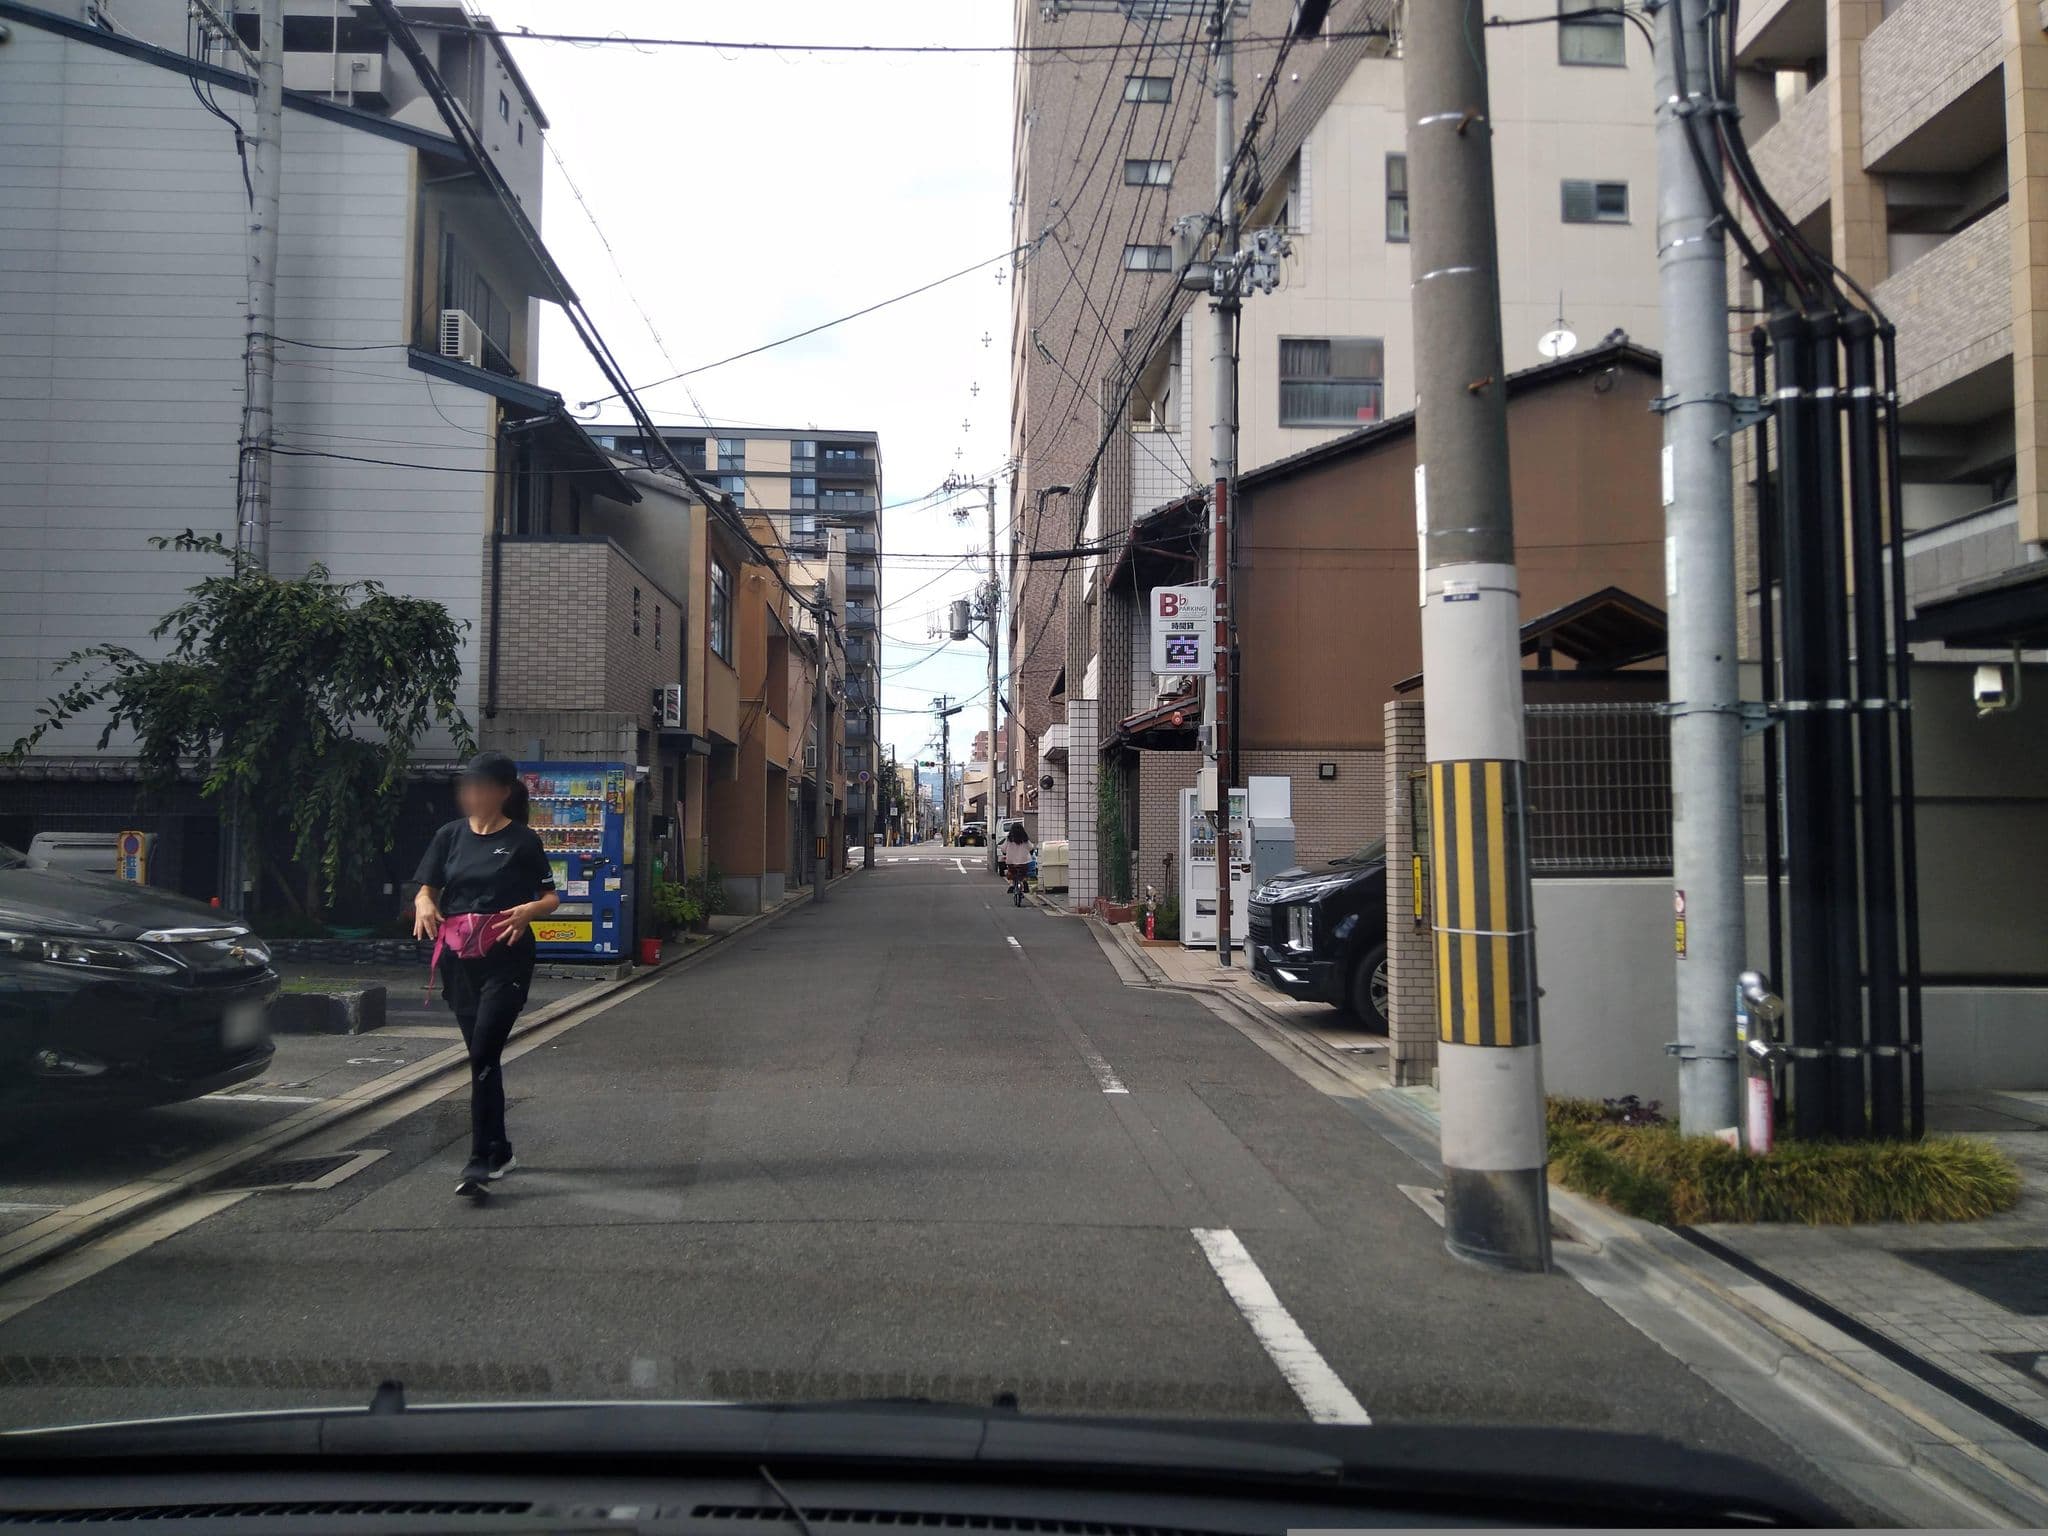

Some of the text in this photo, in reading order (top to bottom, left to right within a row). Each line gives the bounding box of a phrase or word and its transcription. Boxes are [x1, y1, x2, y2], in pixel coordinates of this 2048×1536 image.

[1171, 622, 1194, 630] 時間貸
[1166, 635, 1200, 669] 空
